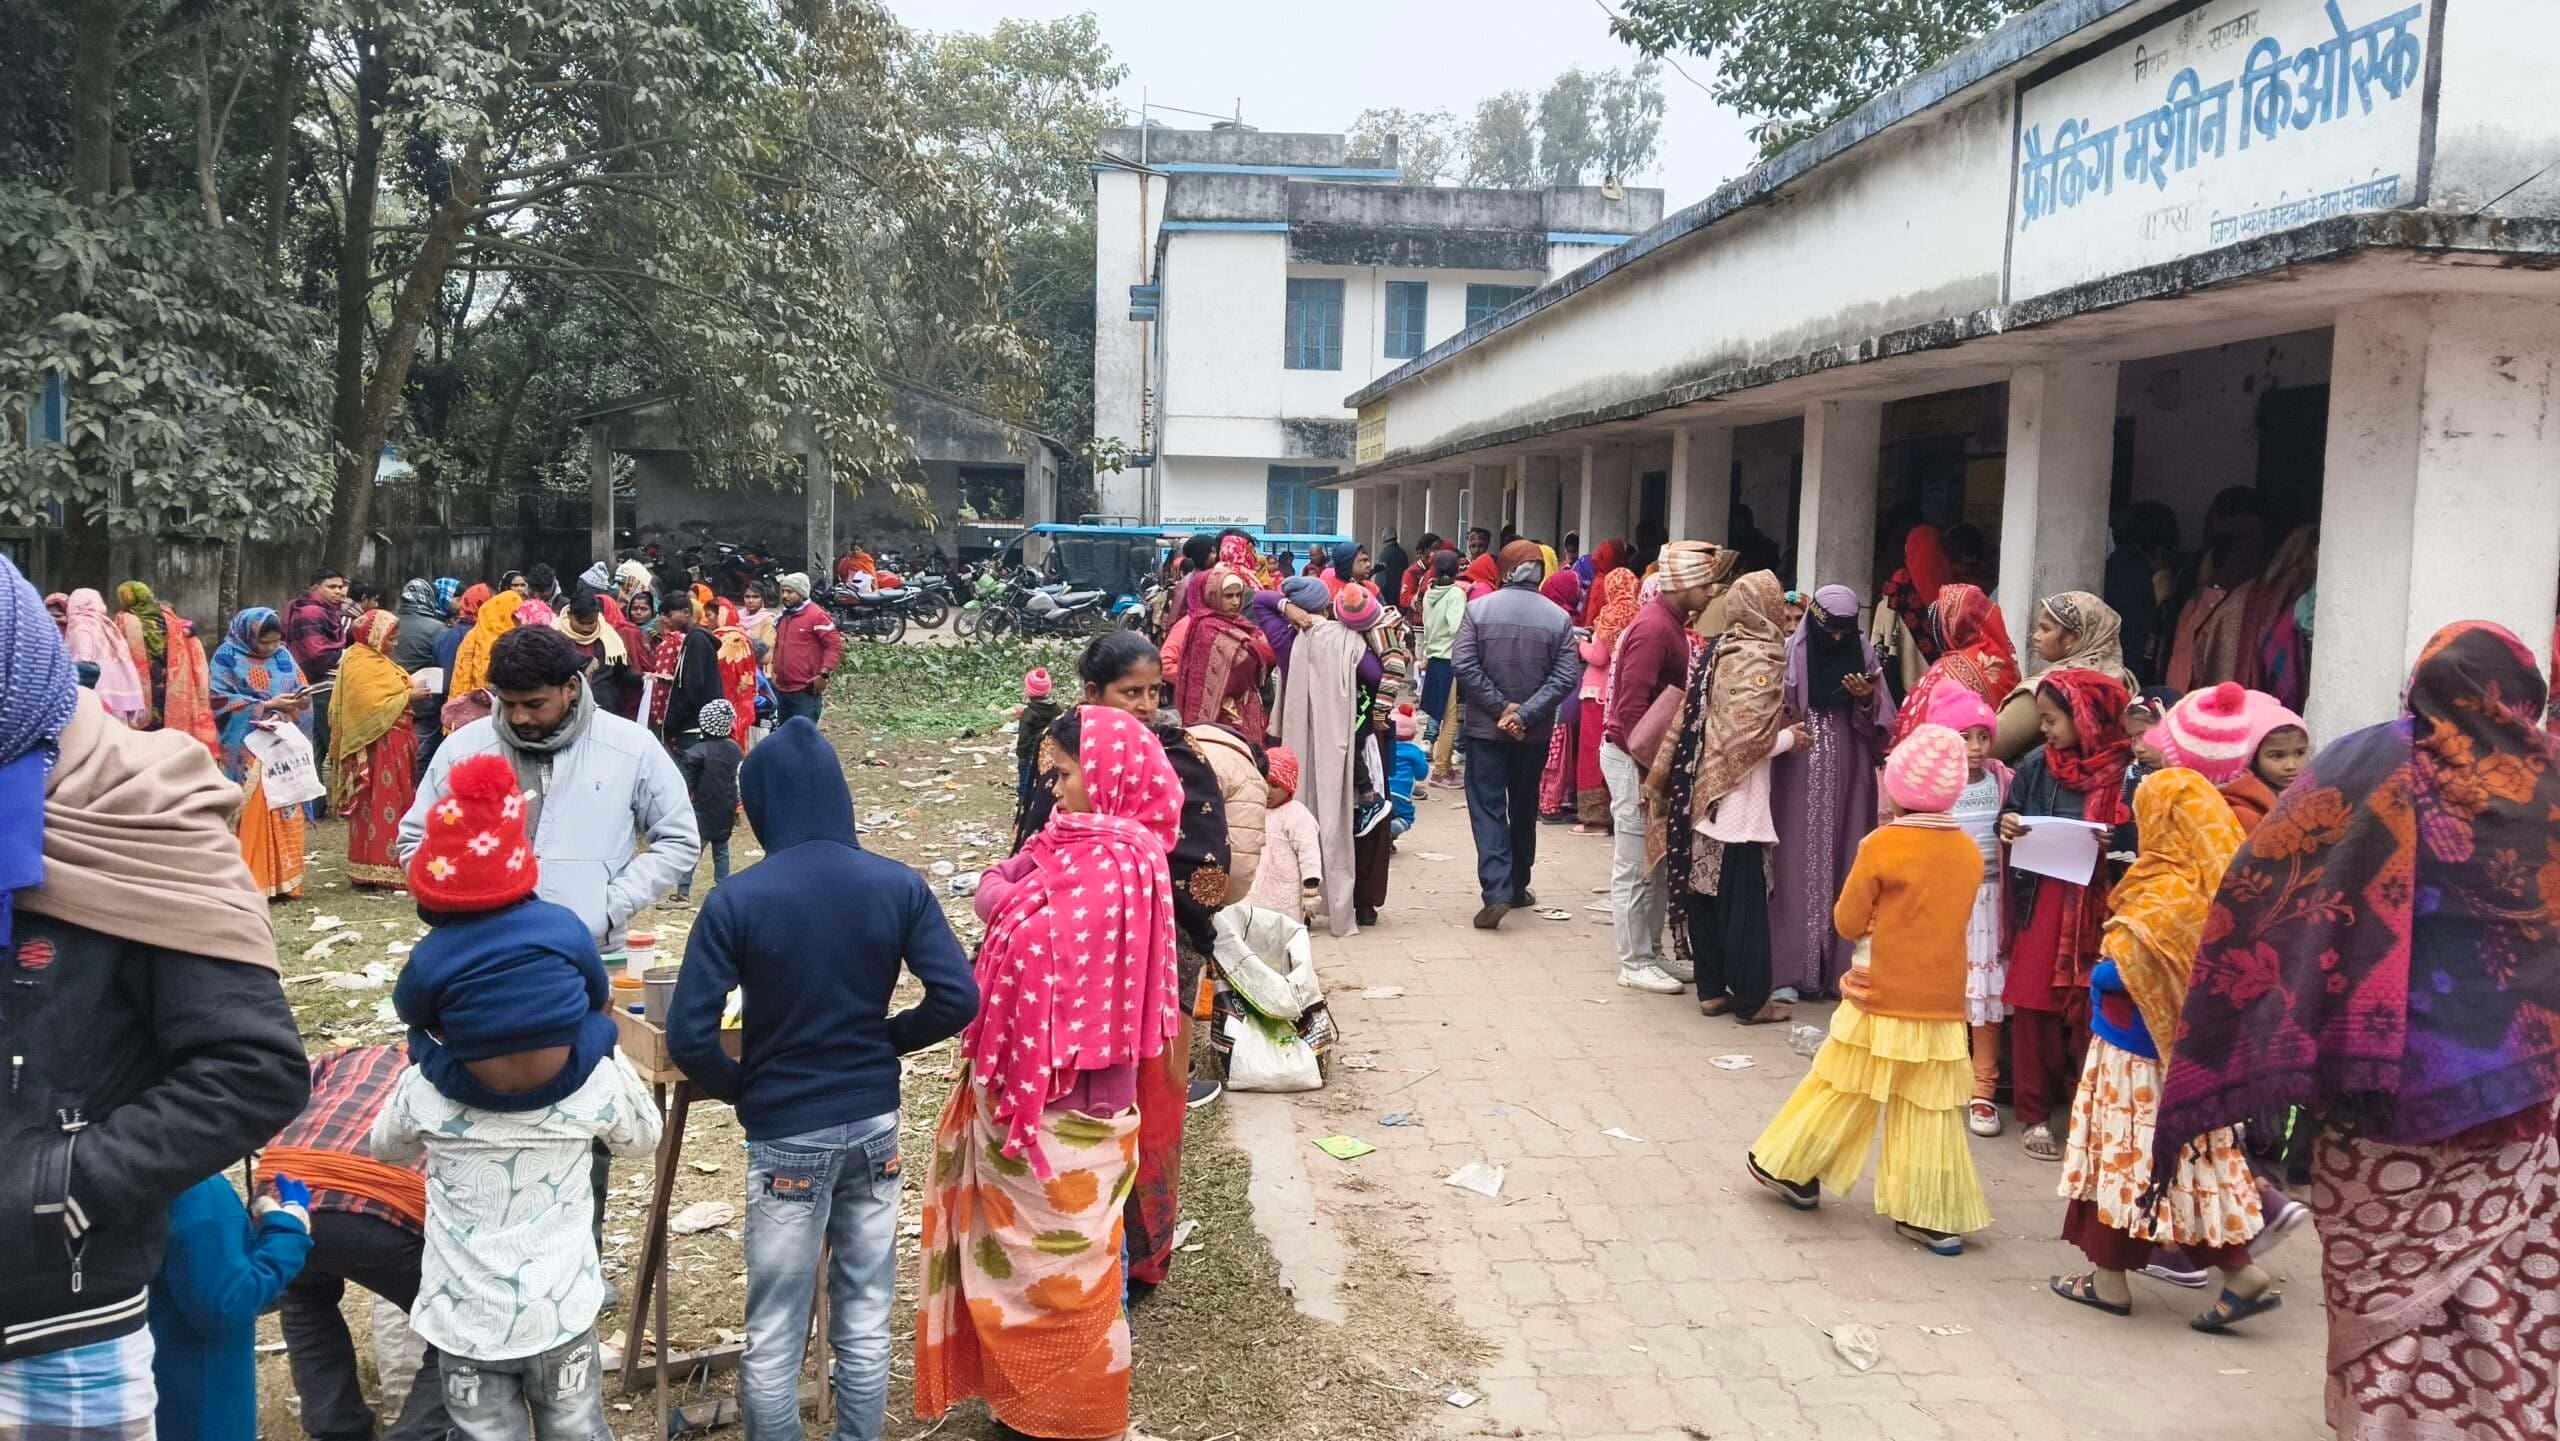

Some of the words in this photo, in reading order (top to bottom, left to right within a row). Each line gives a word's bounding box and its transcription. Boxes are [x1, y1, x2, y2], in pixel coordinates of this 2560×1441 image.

[2207, 8, 2260, 51] सरकार
[2123, 66, 2235, 192] मशीन
[2239, 0, 2423, 151] किओस्क
[2209, 208, 2239, 245] जिला
